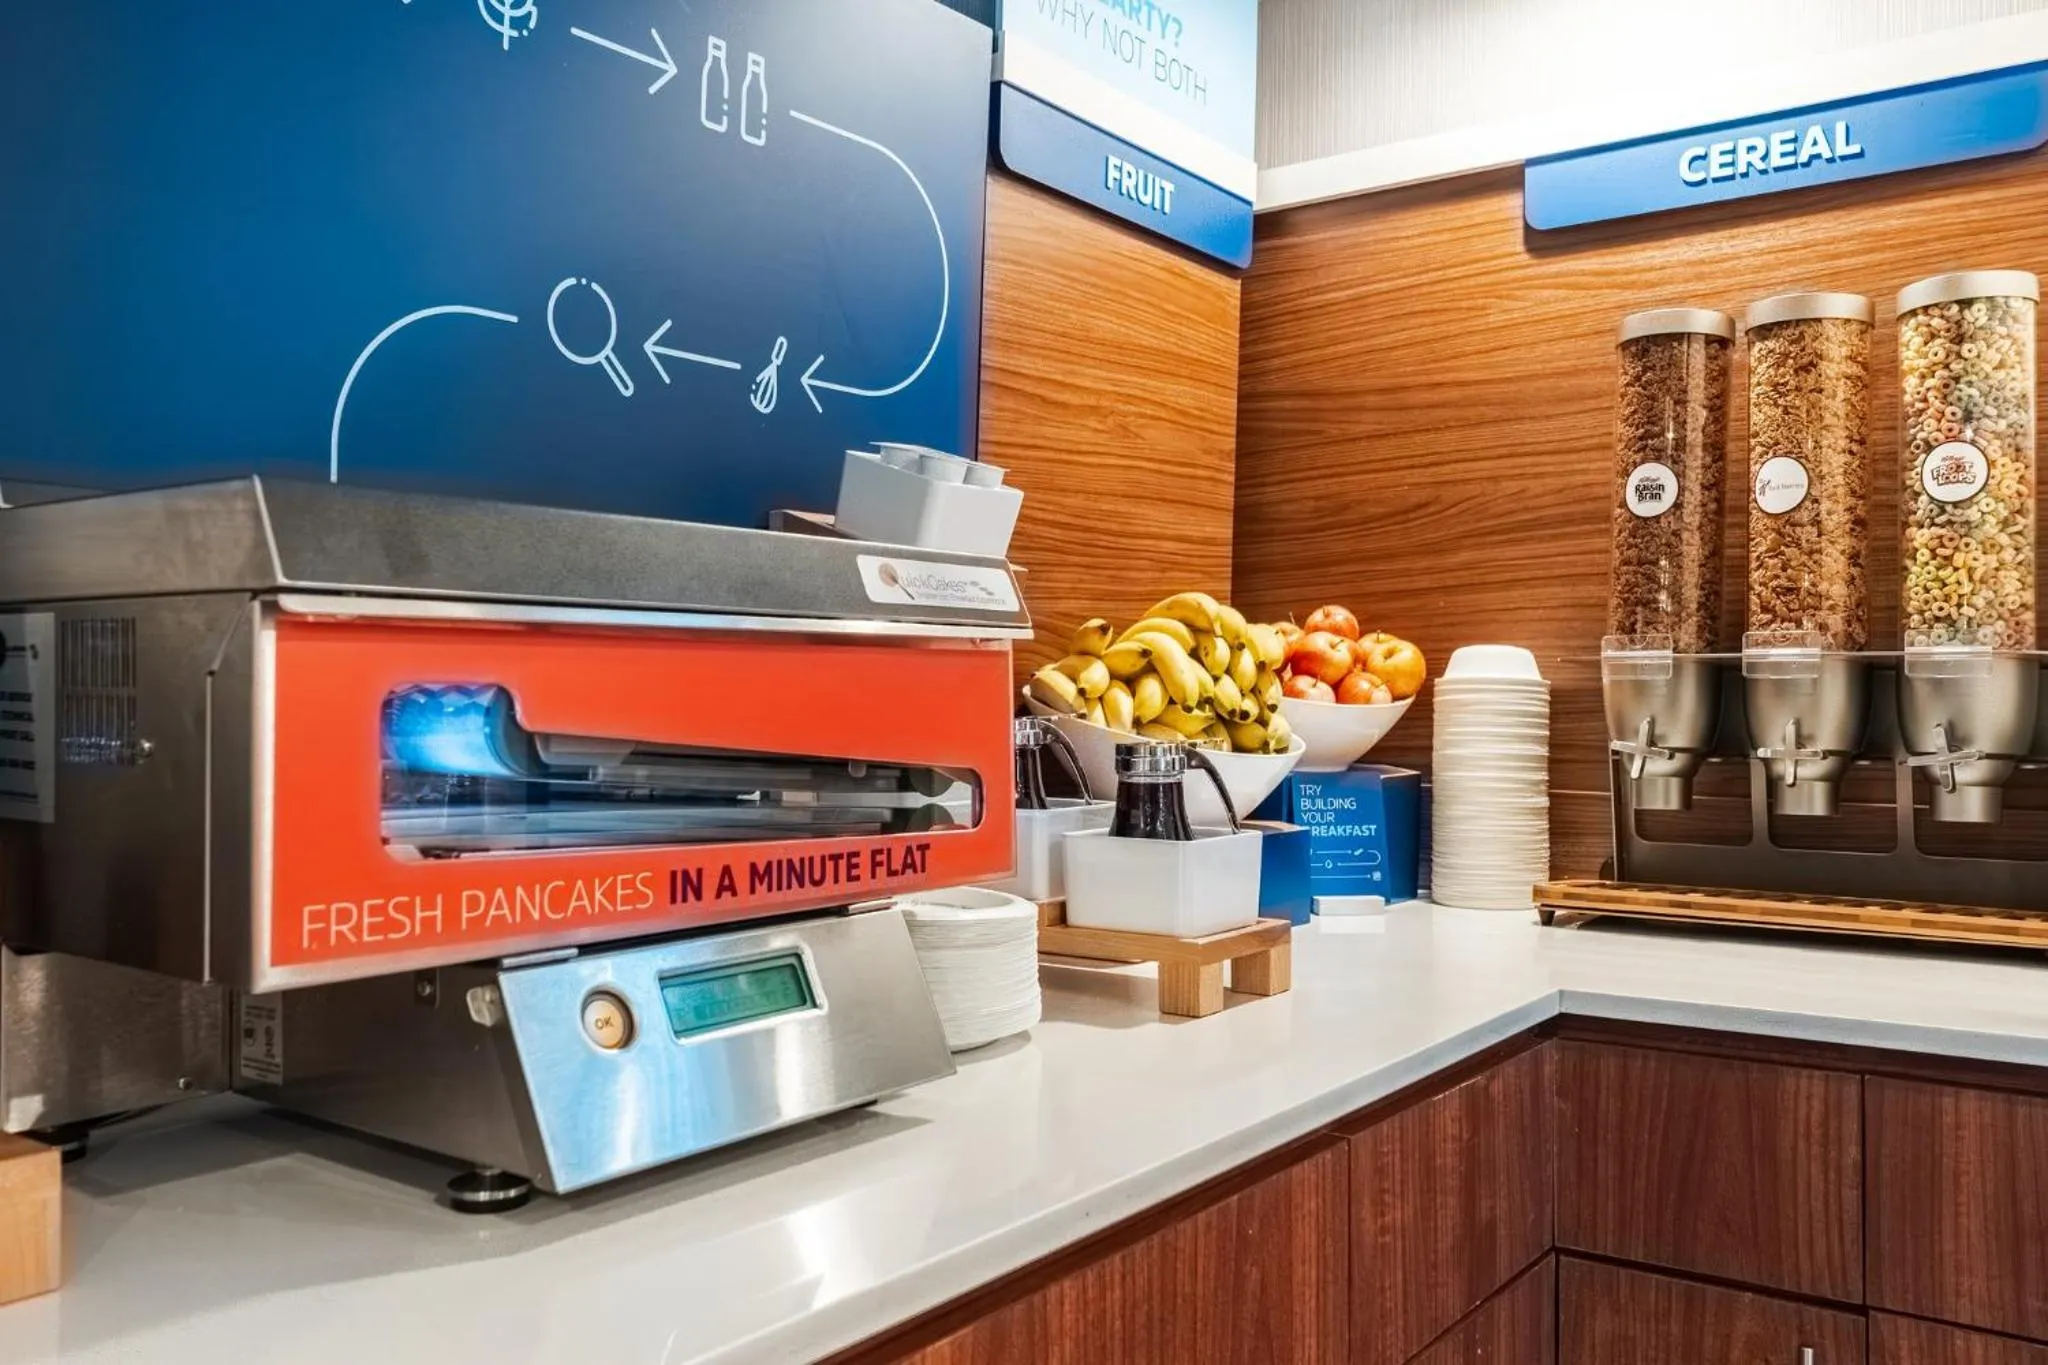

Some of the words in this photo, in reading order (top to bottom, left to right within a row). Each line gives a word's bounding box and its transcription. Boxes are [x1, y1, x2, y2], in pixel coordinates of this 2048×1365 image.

[1098, 0, 1184, 48] ARTY?
[1038, 0, 1096, 40] WHY
[1102, 18, 1147, 71] NOT
[1154, 48, 1208, 106] BOTH
[1678, 120, 1864, 187] CEREAL
[1105, 155, 1176, 216] FRUIT
[1635, 482, 1666, 496] Raisin
[1637, 492, 1662, 503] Bran
[1299, 784, 1322, 796] TRY
[1300, 797, 1357, 810] BUILDING
[1301, 811, 1336, 824] YOUR
[1311, 825, 1377, 837] REAKFAST
[301, 894, 443, 950] FRESH
[460, 872, 655, 931] PANCAKES
[669, 867, 704, 906] IN
[714, 864, 739, 901] A
[748, 849, 864, 895] MINUTE
[869, 843, 933, 881] FLAT
[594, 1015, 614, 1031] OK
